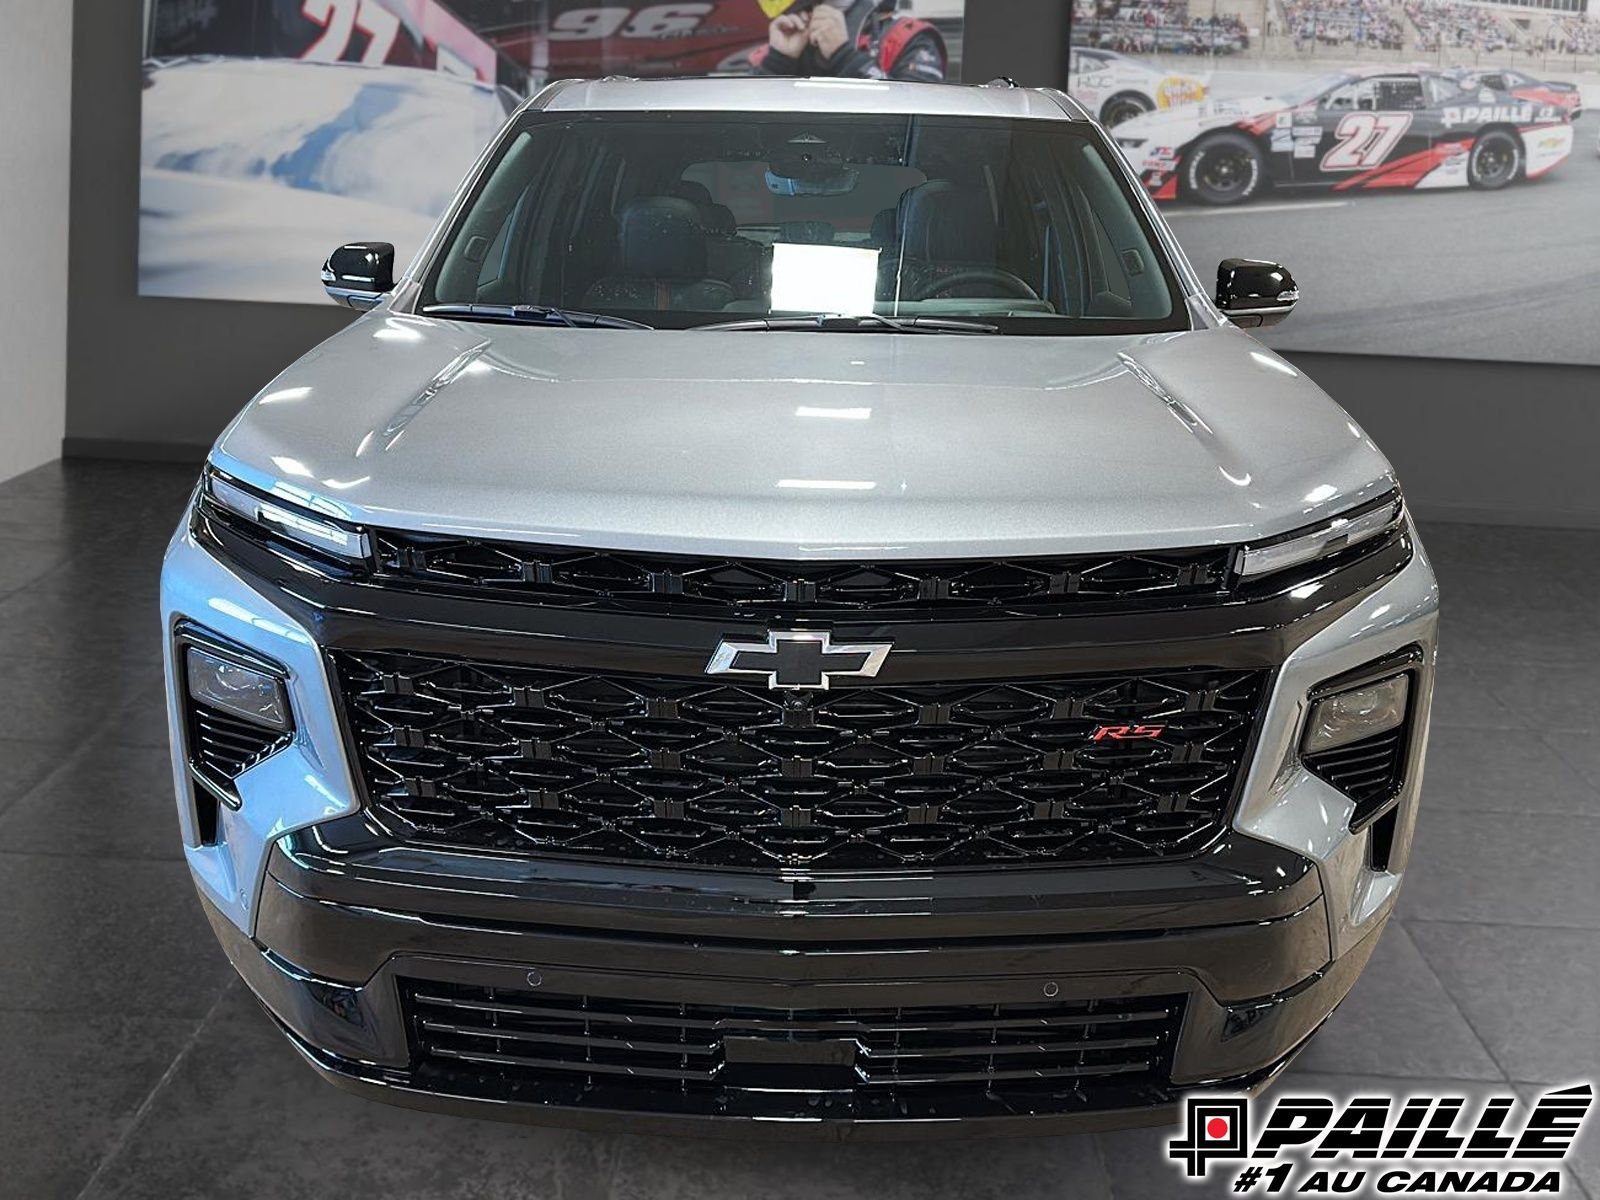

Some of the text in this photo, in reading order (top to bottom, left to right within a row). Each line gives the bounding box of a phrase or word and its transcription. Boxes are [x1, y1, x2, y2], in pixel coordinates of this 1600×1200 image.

[548, 3, 714, 41] 96
[1319, 110, 1414, 172] 27
[1092, 723, 1165, 740] RS
